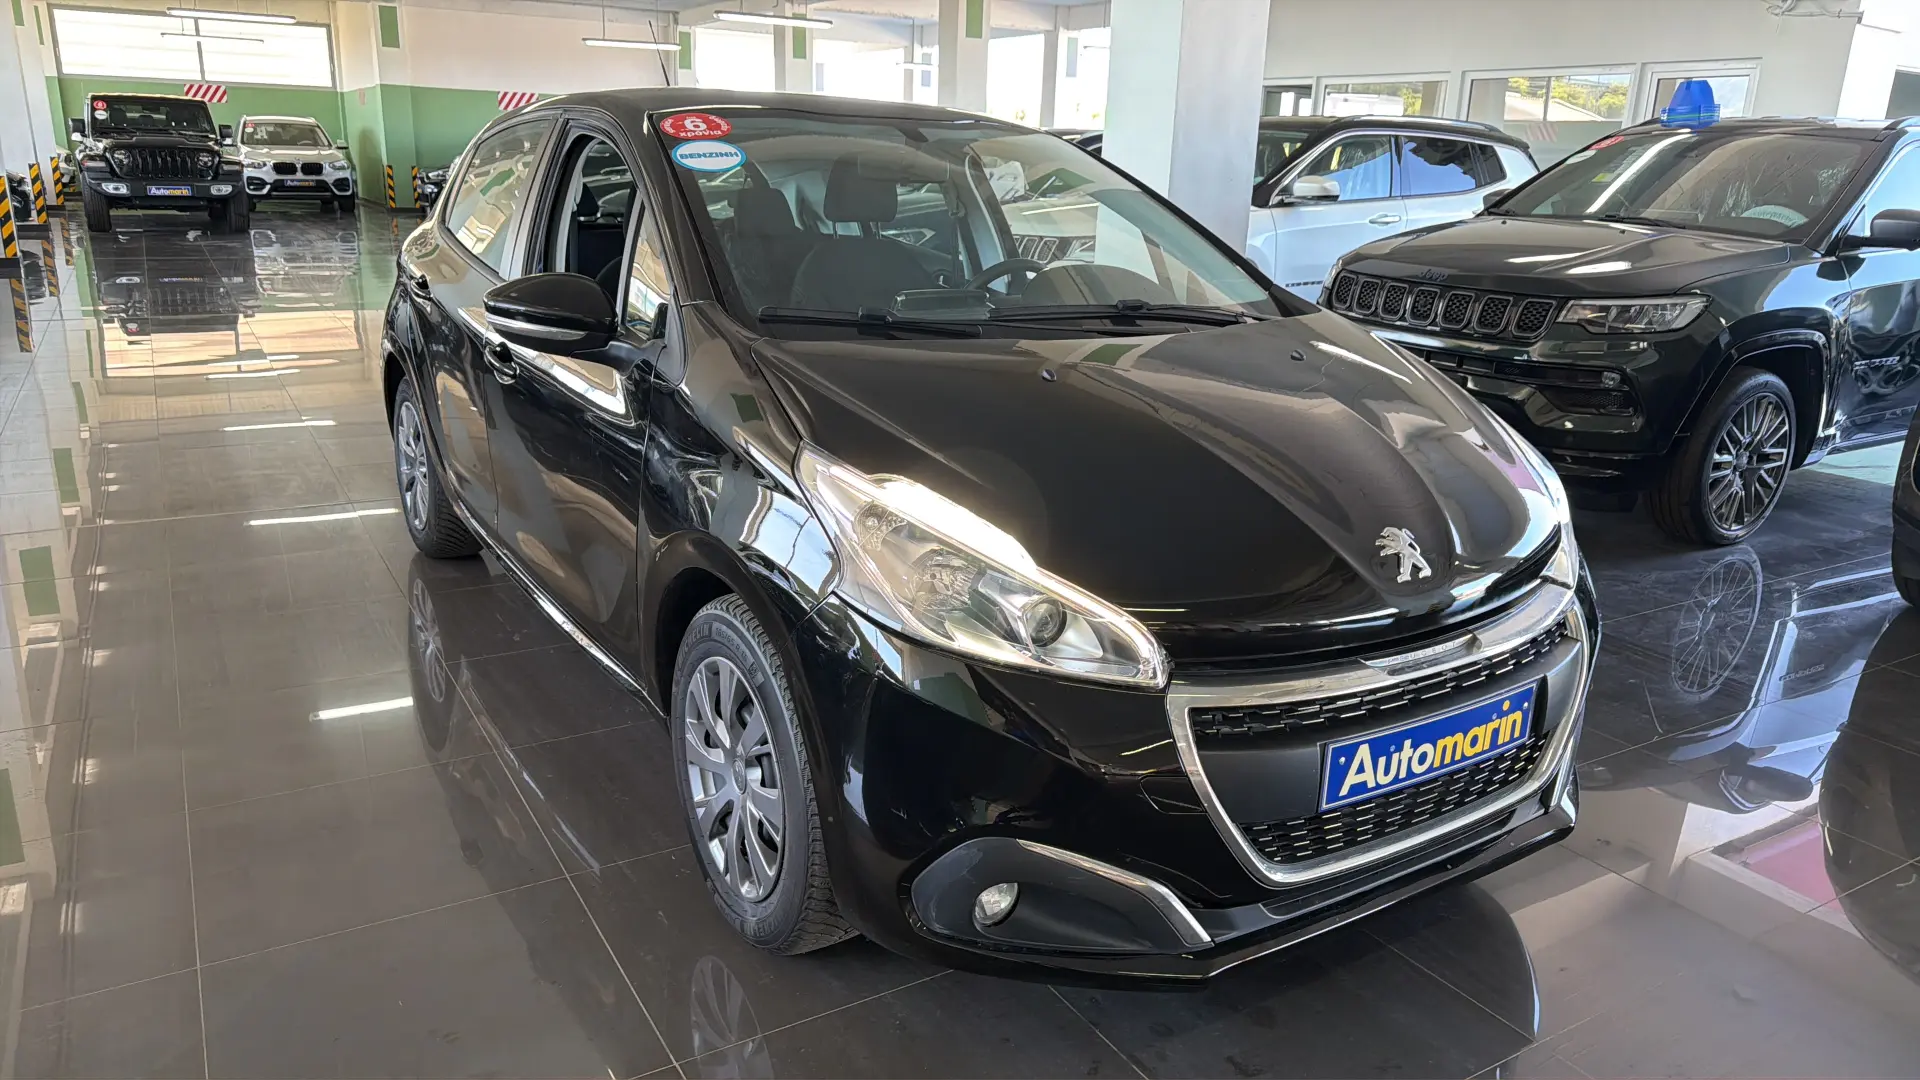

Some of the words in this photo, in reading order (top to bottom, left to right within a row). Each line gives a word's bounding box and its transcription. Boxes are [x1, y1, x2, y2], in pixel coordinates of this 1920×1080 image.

[684, 118, 707, 131] 6
[679, 129, 722, 137] χρόνια
[150, 186, 189, 195] Automarin
[1338, 700, 1523, 797] Automarin
